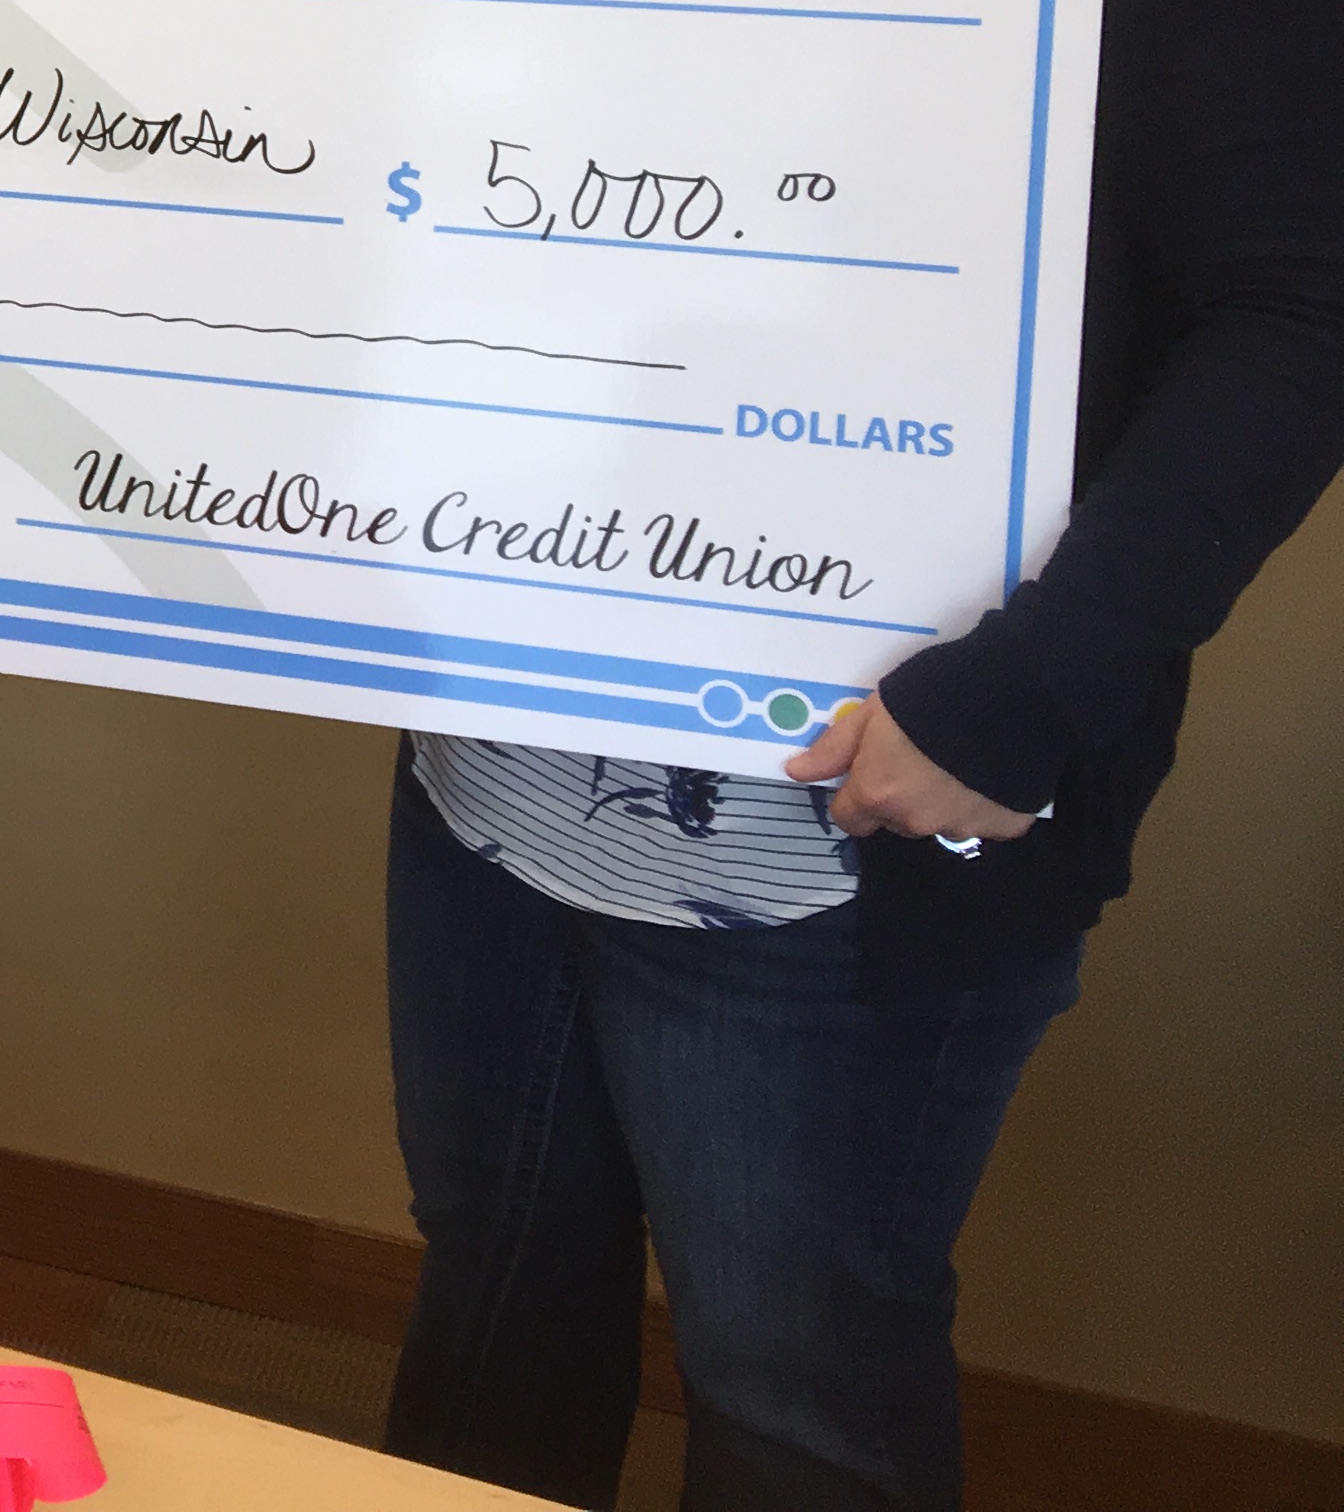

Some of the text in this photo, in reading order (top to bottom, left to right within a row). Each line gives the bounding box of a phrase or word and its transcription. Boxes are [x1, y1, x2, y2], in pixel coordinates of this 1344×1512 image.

[385, 161, 424, 223] $
[735, 404, 955, 458] DOLLARS
[73, 448, 874, 601] UnitedOne Credit Union
